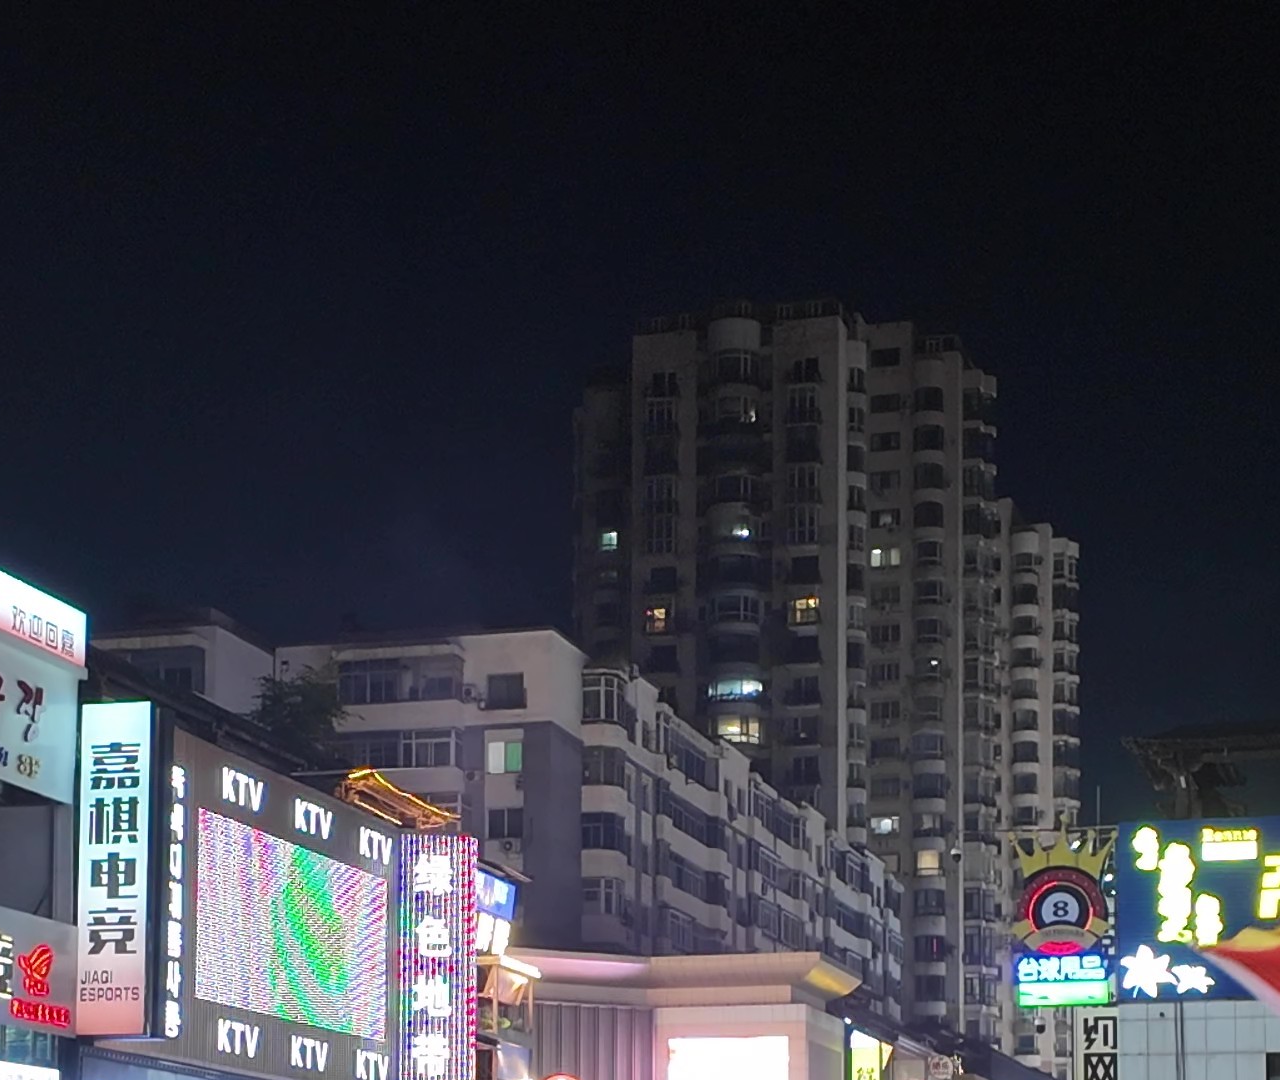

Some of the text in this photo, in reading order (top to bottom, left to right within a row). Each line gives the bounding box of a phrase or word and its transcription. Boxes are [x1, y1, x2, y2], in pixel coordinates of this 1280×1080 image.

[12, 605, 75, 658] 欢迎回嘉
[221, 766, 264, 812] KTV
[294, 798, 333, 841] KTV
[88, 742, 141, 956] 嘉棋电竞
[359, 826, 394, 866] KTV
[1051, 900, 1070, 918] 8
[1018, 955, 1105, 982] 台球用品
[79, 986, 140, 1002] ESPORTS
[217, 1018, 259, 1059] KTV
[290, 1035, 328, 1073] KTV
